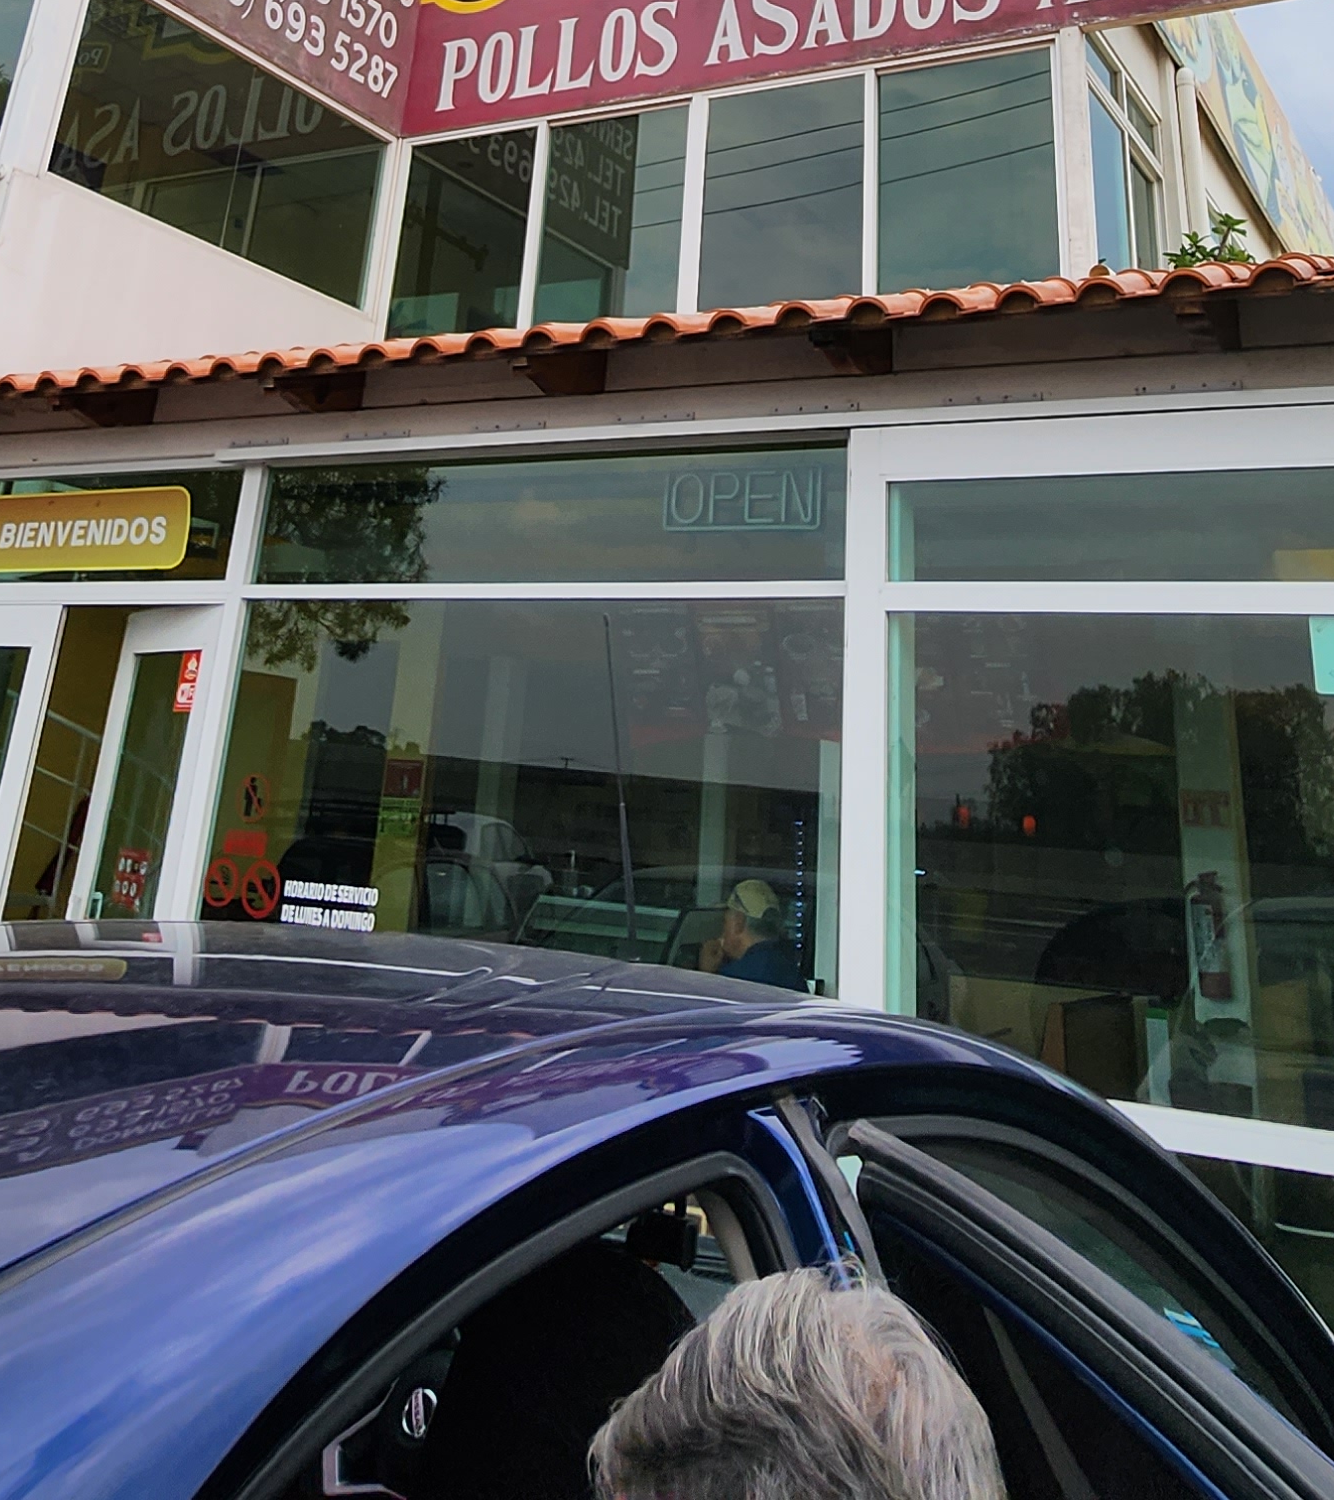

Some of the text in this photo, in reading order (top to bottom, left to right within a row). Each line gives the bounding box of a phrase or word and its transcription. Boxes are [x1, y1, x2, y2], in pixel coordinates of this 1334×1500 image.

[330, 43, 399, 99] 5287
[435, 0, 678, 111] POLLOS
[670, 468, 814, 525] OPEN
[280, 904, 376, 933] DE LUNES A DOMINGO
[284, 880, 379, 907] HORARIO DE SERVICIO
